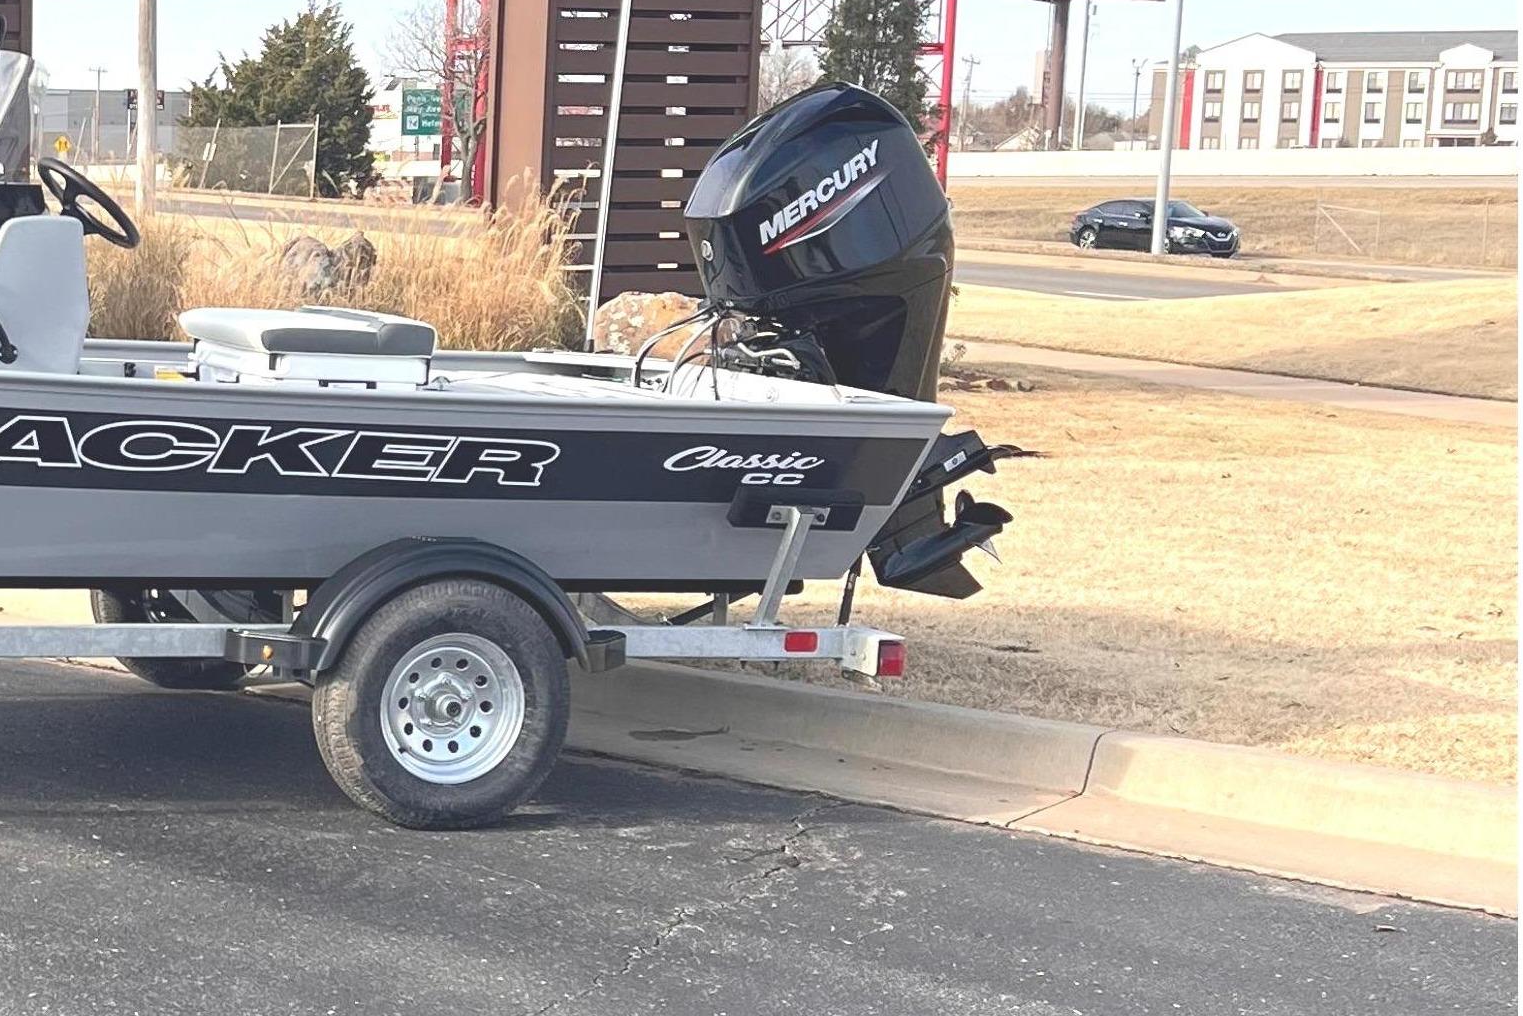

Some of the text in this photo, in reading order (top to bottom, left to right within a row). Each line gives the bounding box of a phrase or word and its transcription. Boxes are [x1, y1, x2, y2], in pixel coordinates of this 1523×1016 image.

[759, 138, 880, 246] MERCURY
[663, 445, 826, 472] Classic
[741, 472, 806, 486] CC
